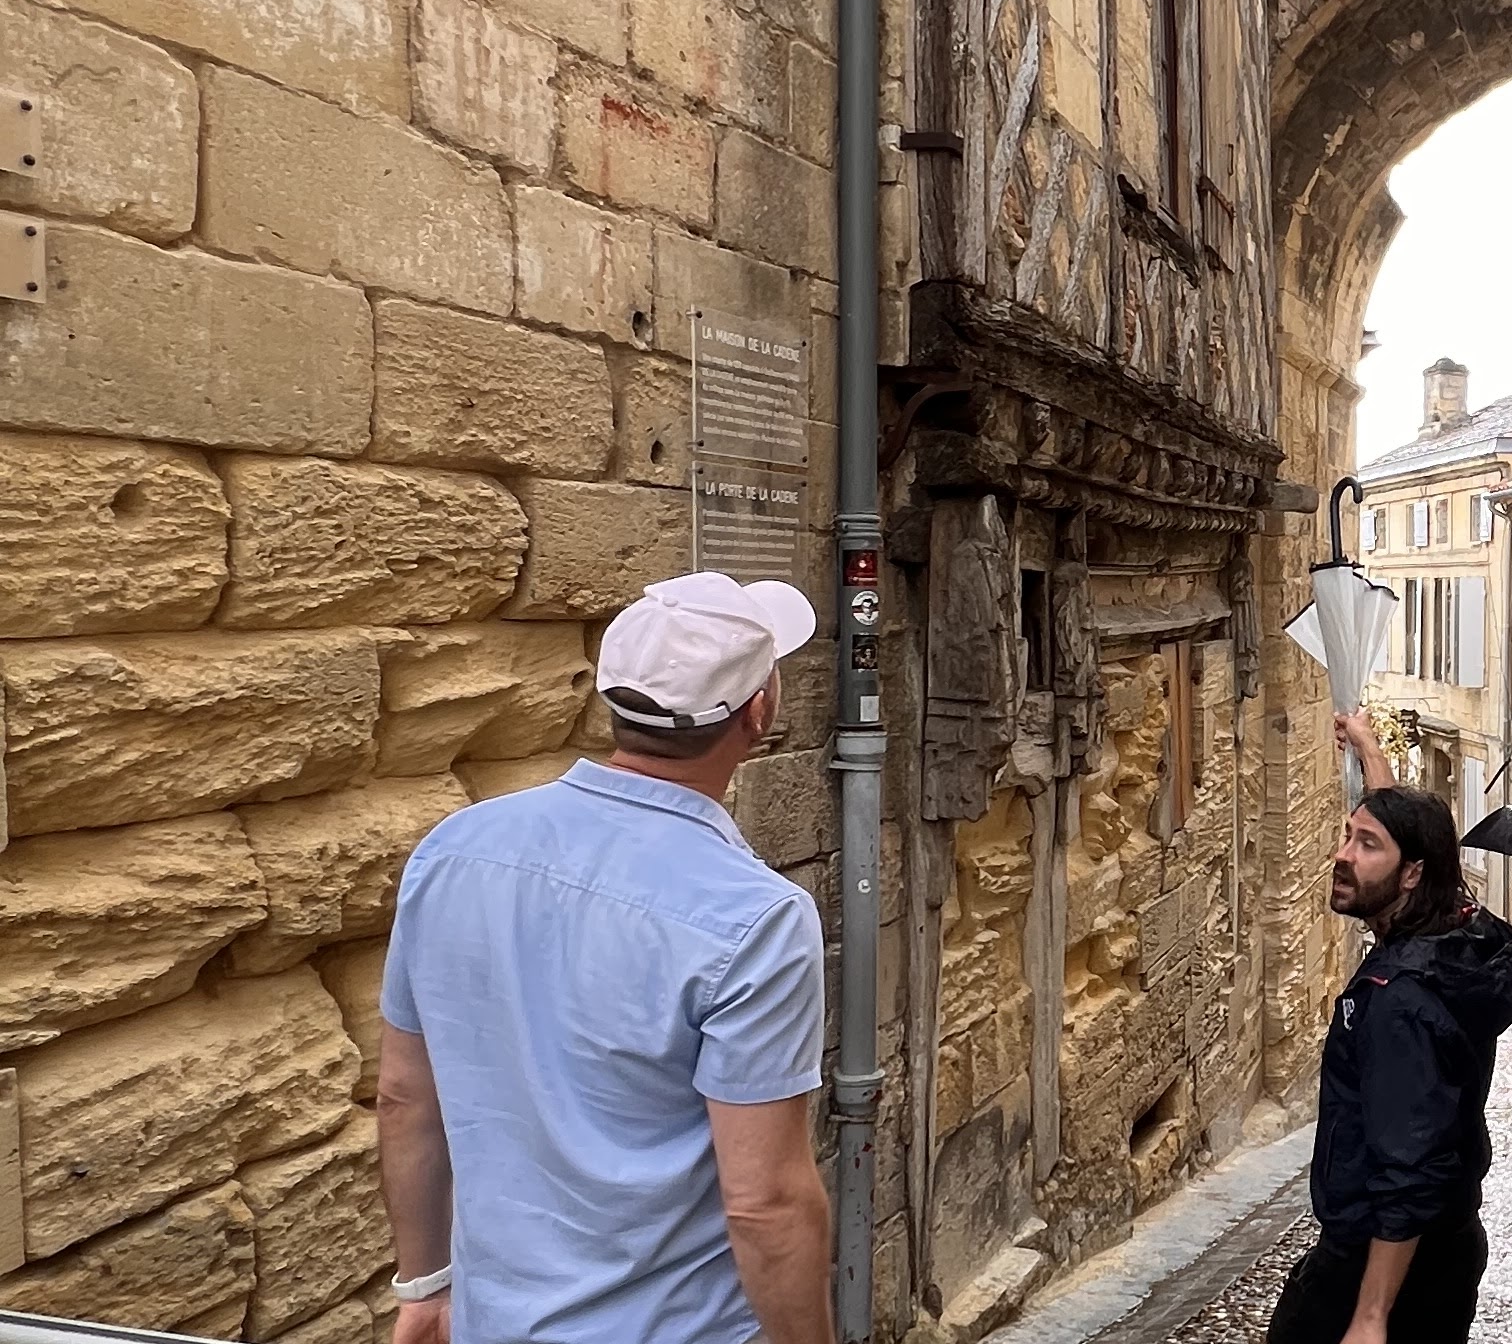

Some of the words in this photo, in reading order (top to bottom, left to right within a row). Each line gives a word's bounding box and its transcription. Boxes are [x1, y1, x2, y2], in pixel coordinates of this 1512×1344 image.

[702, 325, 713, 341] LA
[761, 340, 772, 356] LA
[705, 481, 716, 496] LA
[758, 487, 769, 501] LA
